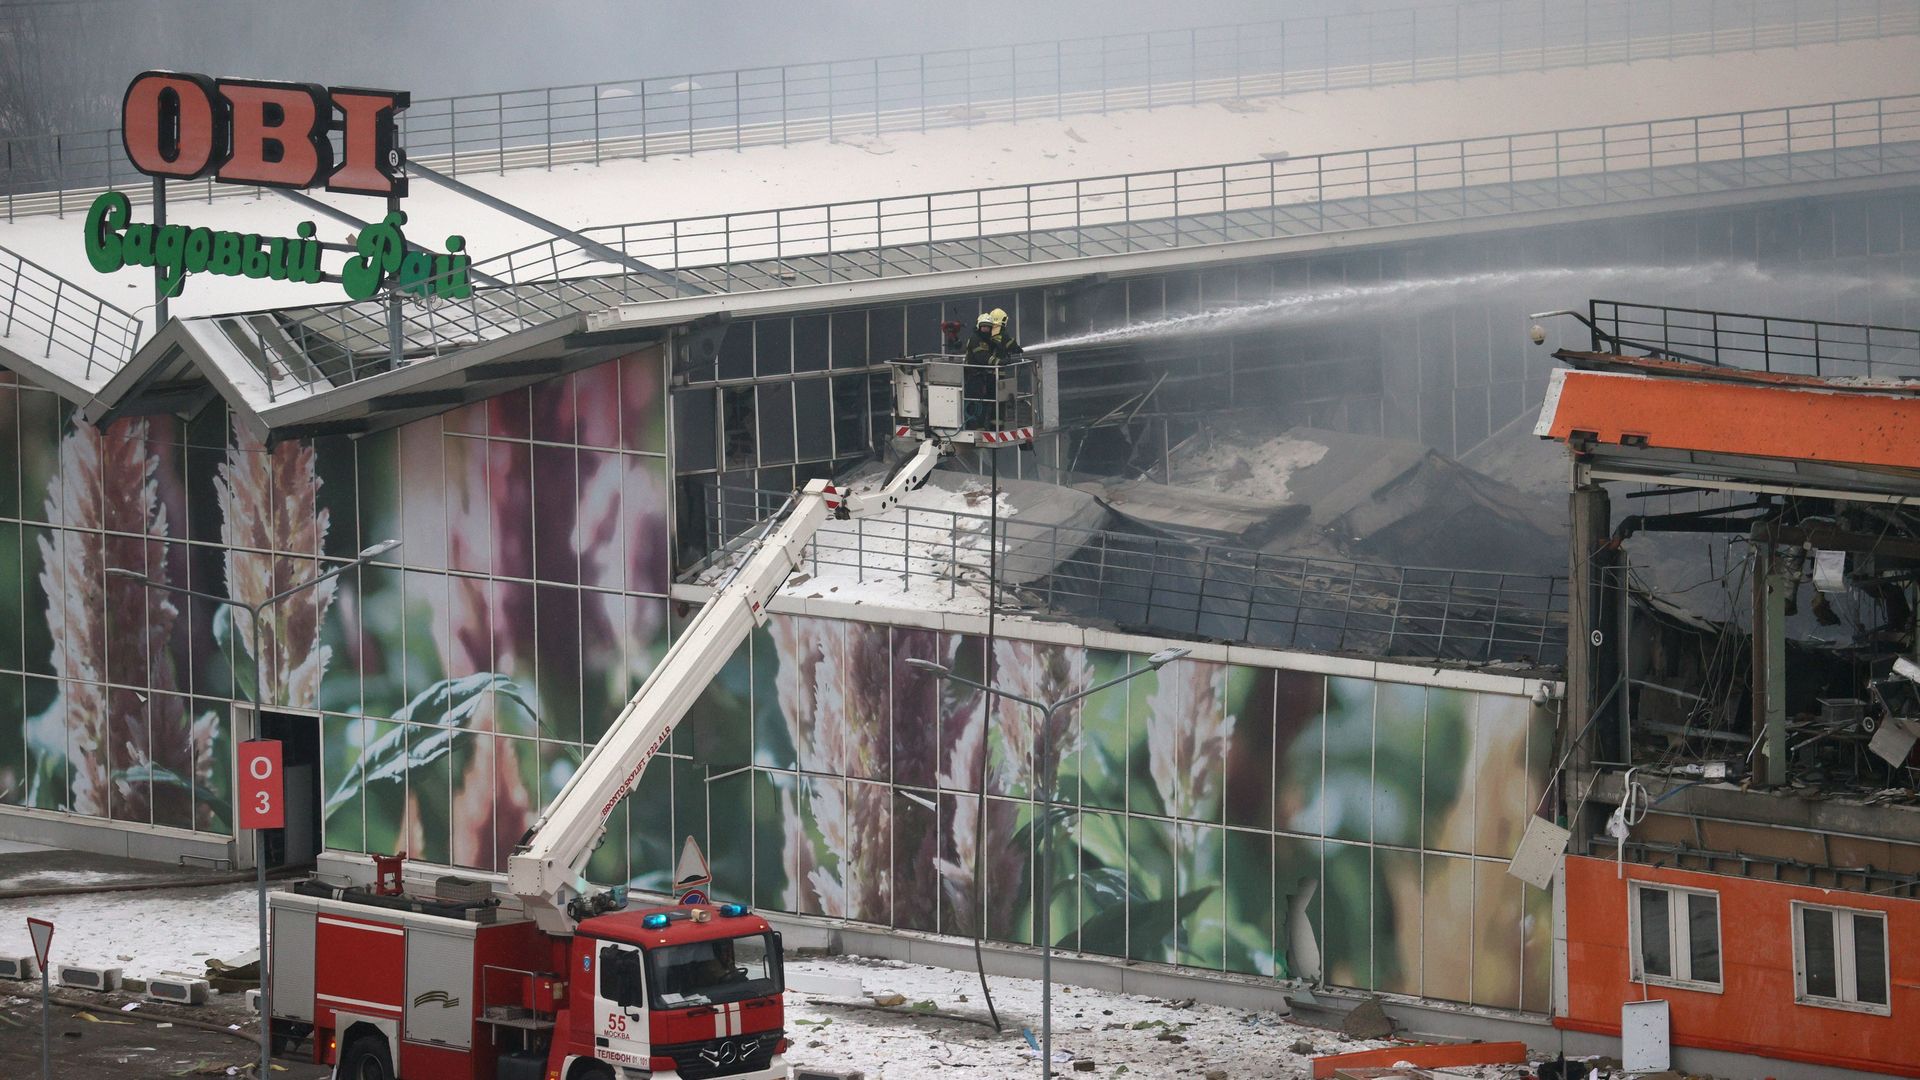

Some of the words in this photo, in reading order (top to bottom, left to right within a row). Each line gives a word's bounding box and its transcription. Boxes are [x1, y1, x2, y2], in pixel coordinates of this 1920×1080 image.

[122, 70, 410, 198] OBI
[84, 191, 326, 298] Садовый
[342, 210, 472, 299] Рай
[601, 785, 626, 816] BRONTO
[624, 758, 646, 788] SKYLIFT
[659, 725, 671, 743] ALR
[255, 791, 270, 814] 3
[608, 1013, 626, 1032] 55
[603, 1030, 630, 1040] МОСКВА
[597, 1050, 631, 1063] ТЕЛЕФОН
